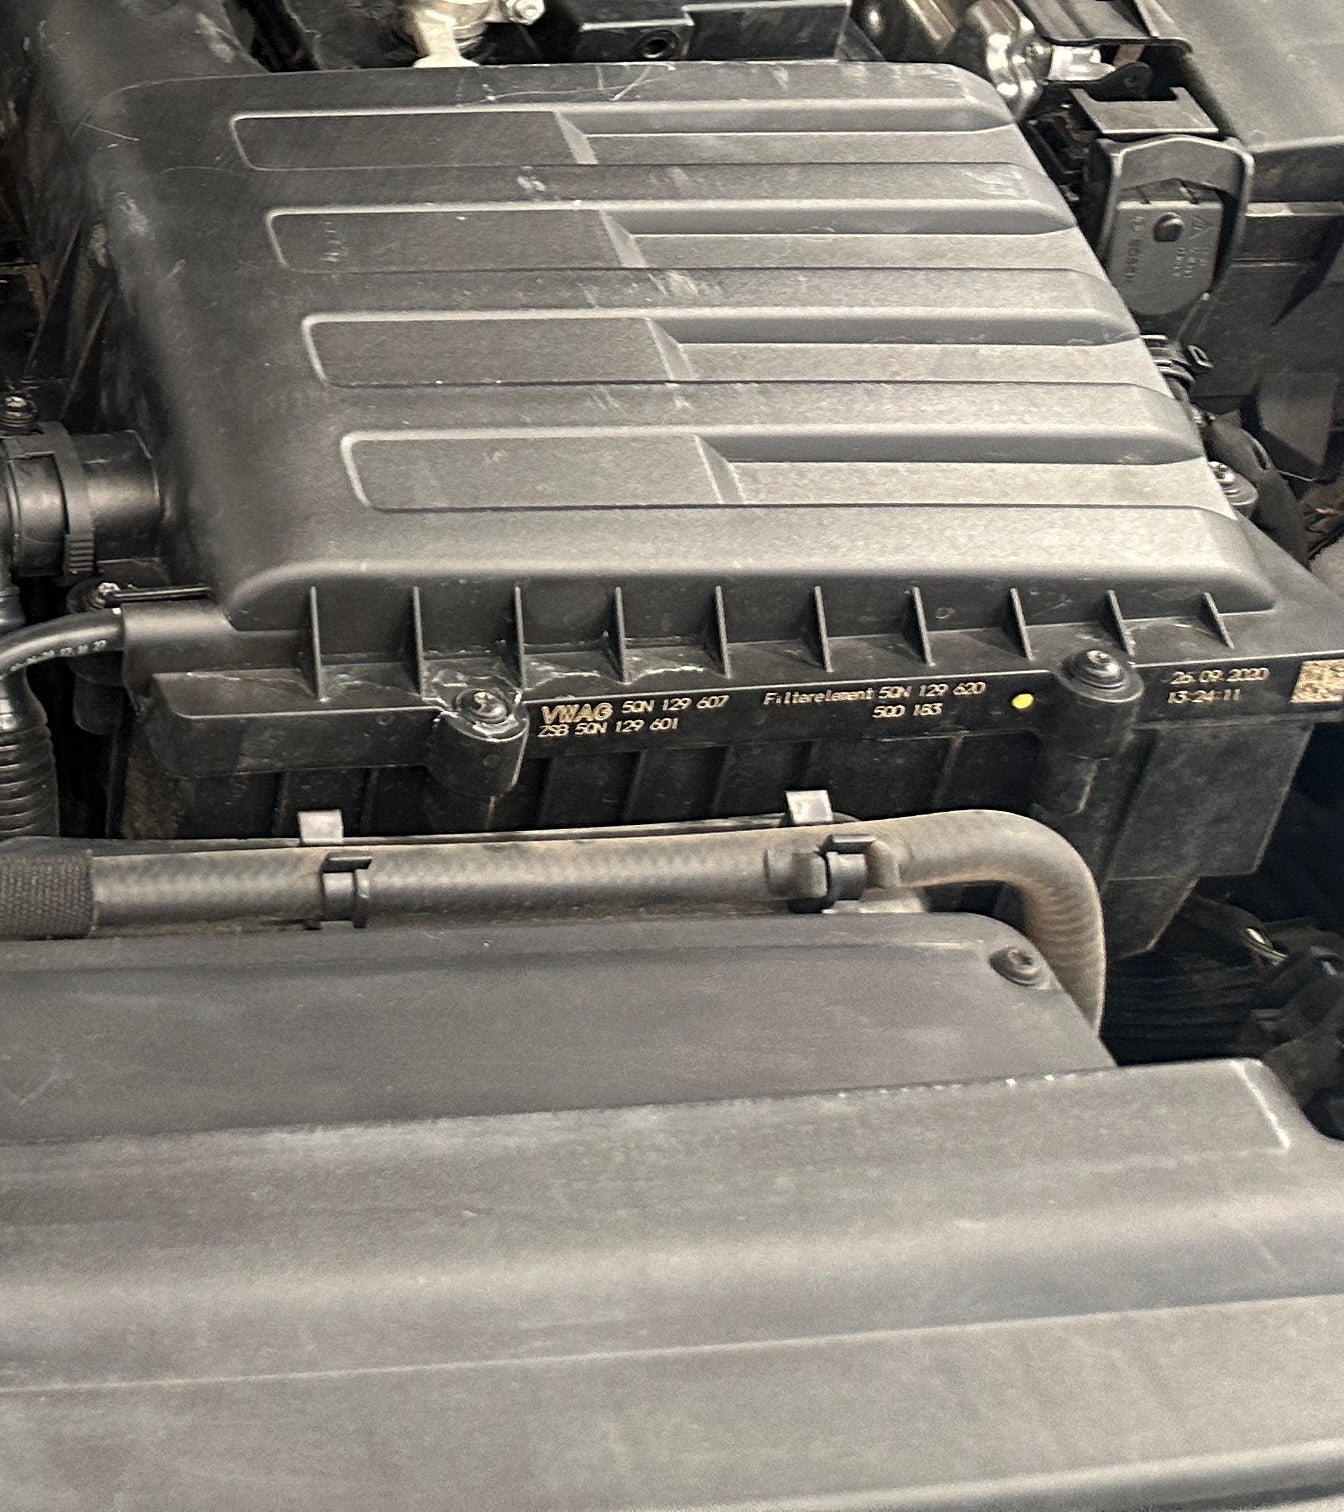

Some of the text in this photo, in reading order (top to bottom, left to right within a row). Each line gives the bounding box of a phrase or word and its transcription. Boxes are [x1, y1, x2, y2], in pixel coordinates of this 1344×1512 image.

[919, 683, 948, 698] 129
[953, 681, 986, 696] 620
[662, 697, 692, 712] 129
[696, 694, 730, 710] 607
[614, 719, 645, 734] 129
[649, 717, 679, 731] 601
